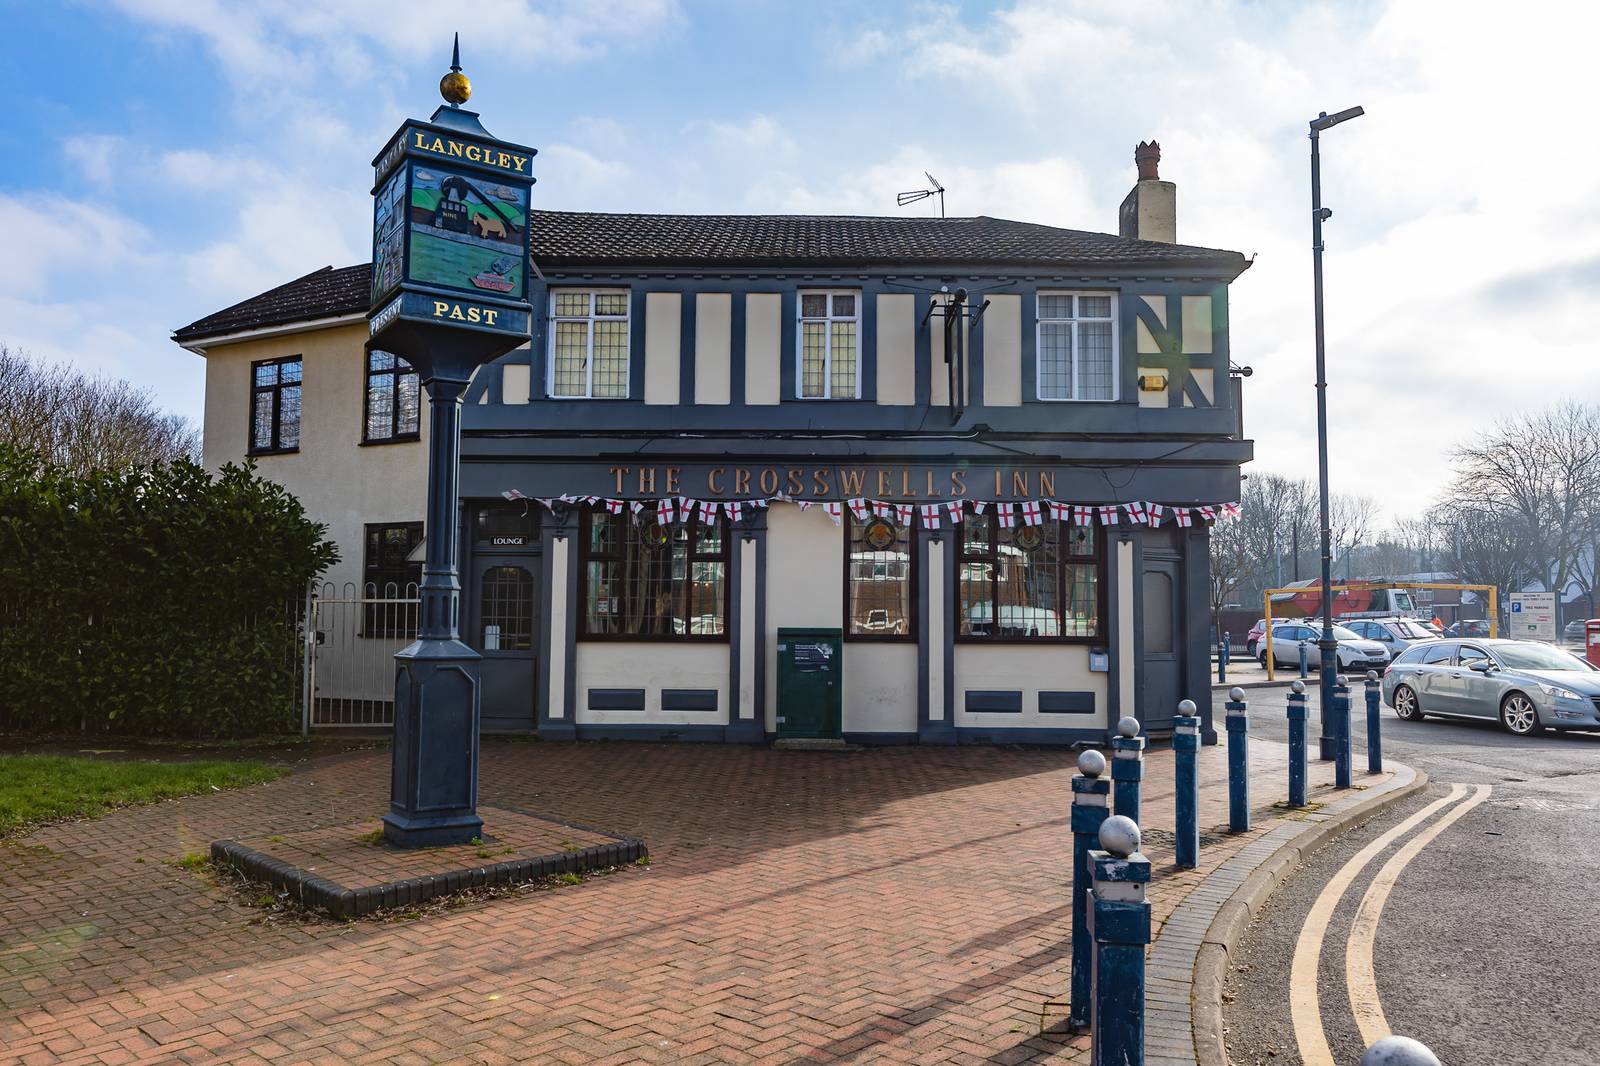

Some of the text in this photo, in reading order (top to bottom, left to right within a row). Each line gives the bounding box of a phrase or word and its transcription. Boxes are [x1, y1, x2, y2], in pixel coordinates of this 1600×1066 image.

[415, 132, 527, 171] LANGLEY
[433, 301, 498, 325] PAST
[609, 466, 1057, 497] THE CROSSWELLS INN
[493, 537, 524, 545] LOUNGE
